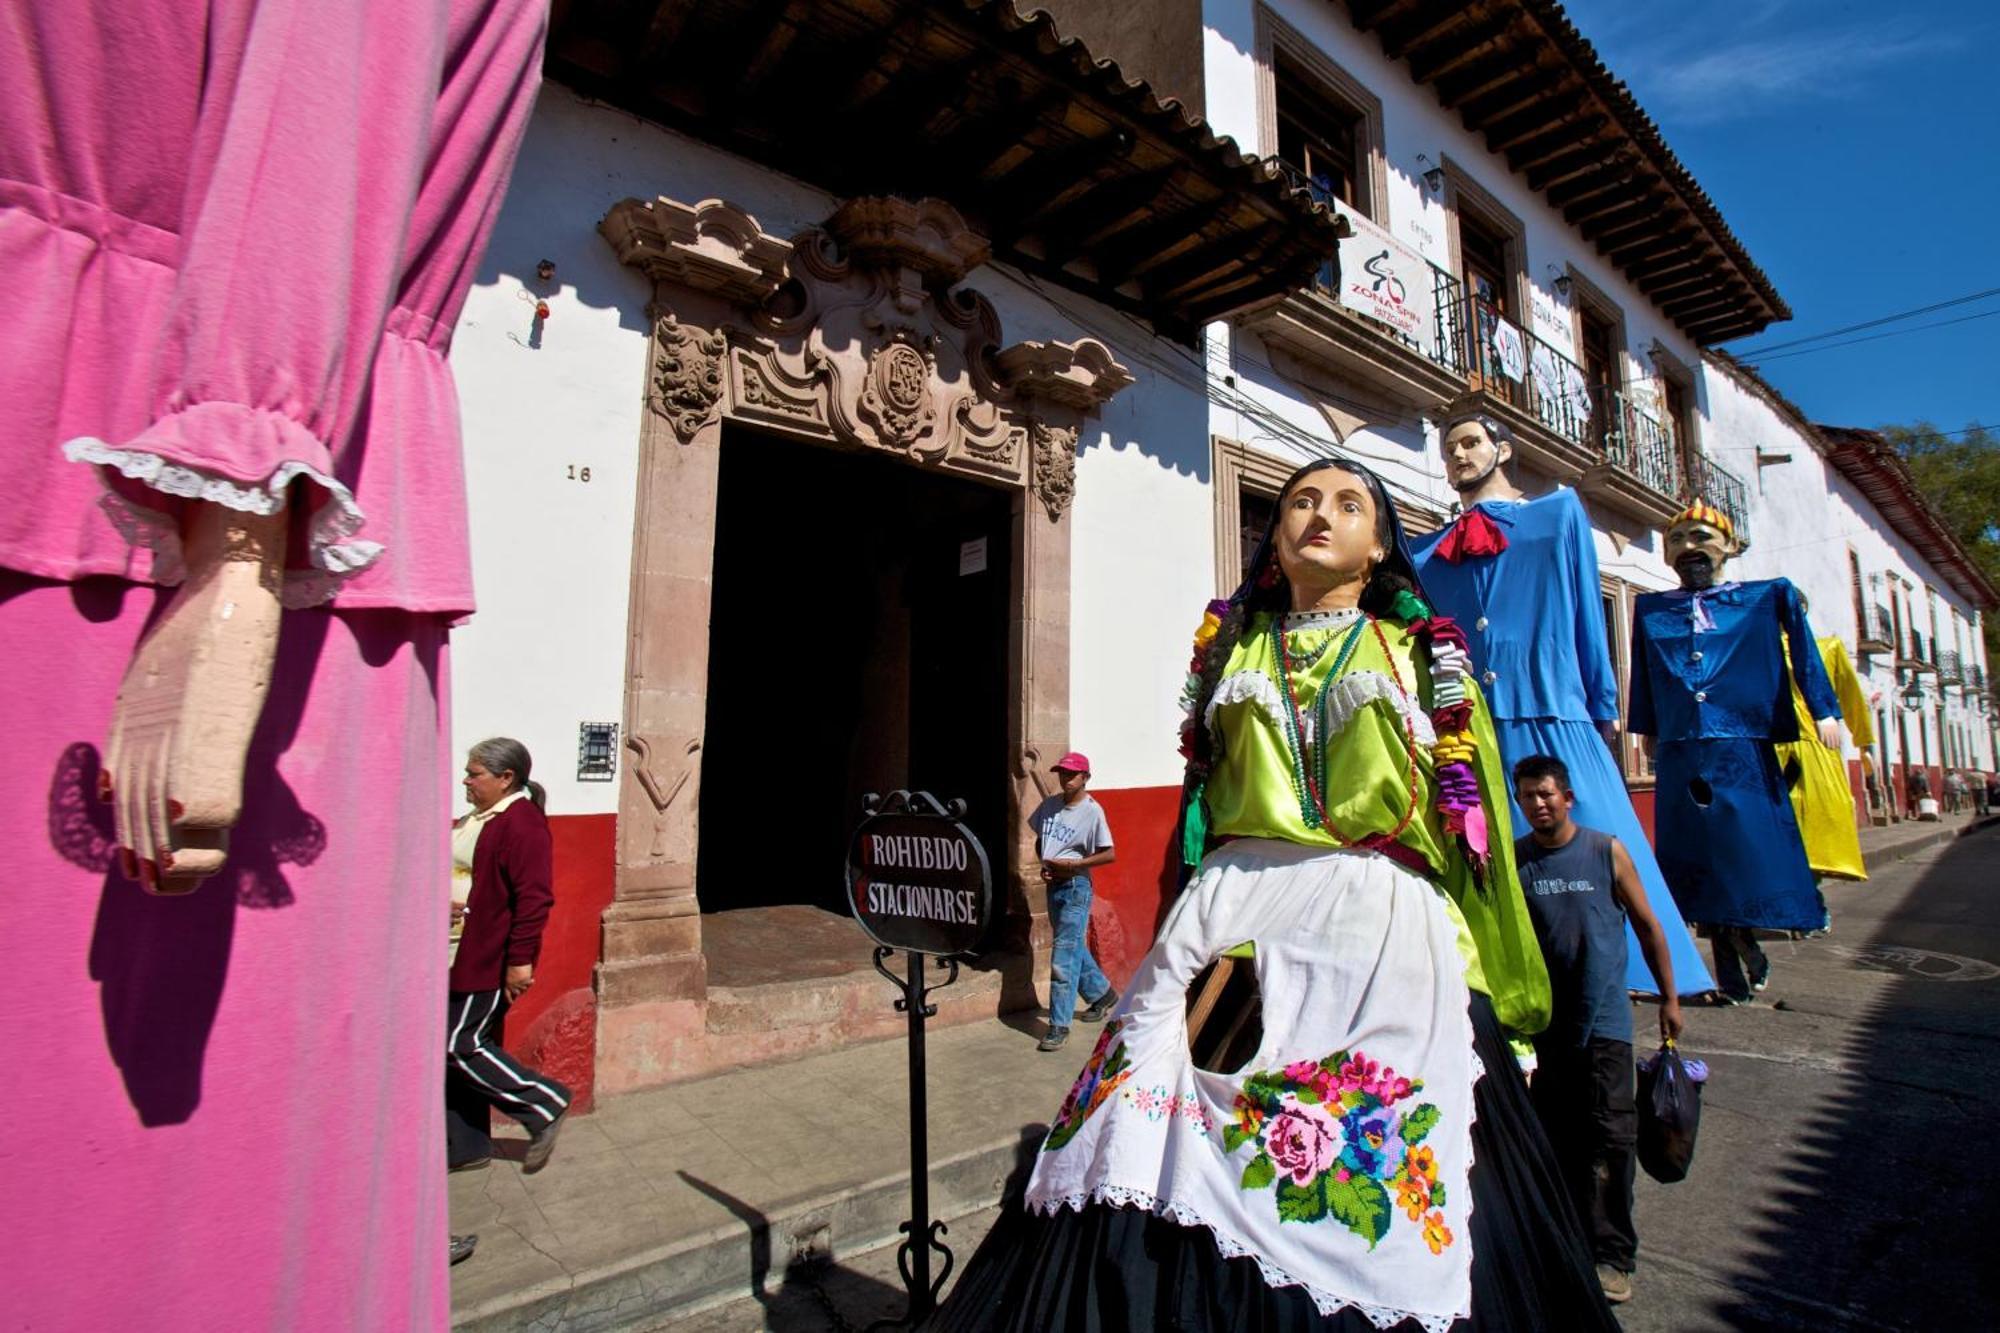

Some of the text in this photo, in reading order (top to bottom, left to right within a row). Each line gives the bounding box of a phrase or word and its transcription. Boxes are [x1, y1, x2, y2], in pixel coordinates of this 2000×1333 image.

[1351, 283, 1421, 325] ZONA SPIN
[567, 464, 592, 483] 16
[862, 833, 968, 871] PROHIBIDO
[855, 879, 978, 925] ESTACIONARSE
